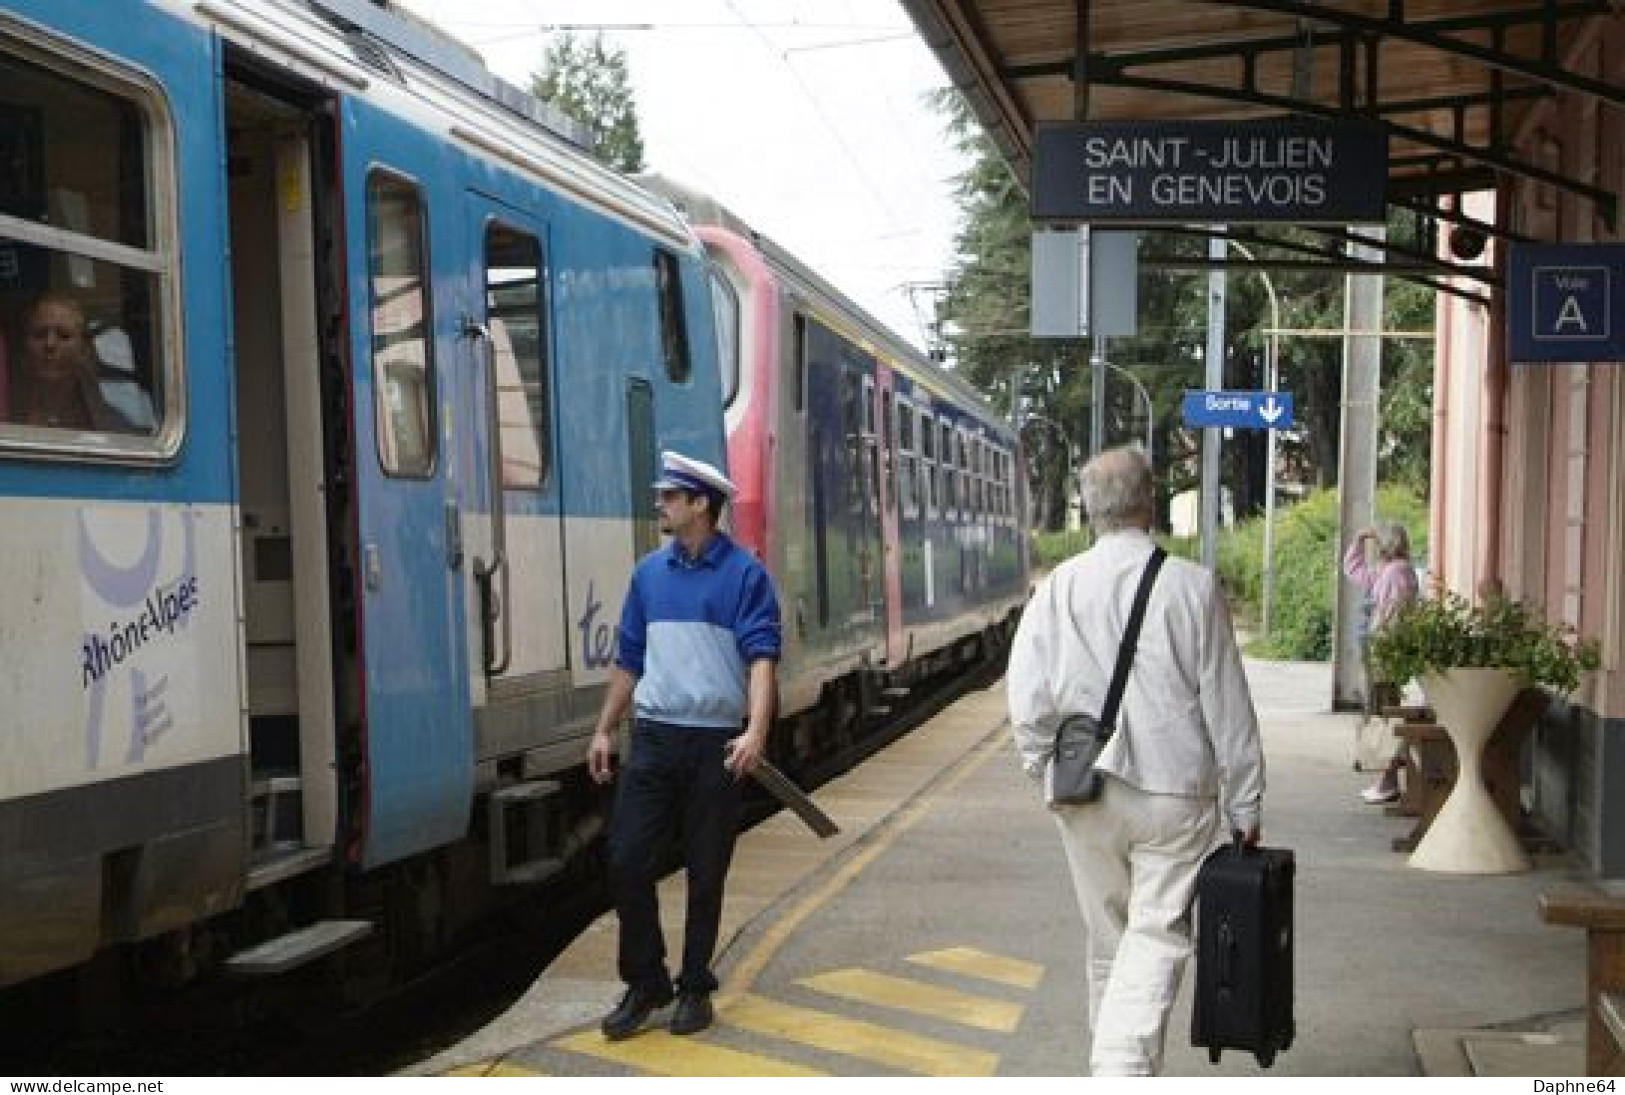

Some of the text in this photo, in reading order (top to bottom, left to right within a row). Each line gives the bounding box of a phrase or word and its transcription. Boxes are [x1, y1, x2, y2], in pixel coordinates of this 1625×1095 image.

[1088, 174, 1326, 205] EN GENEVOIS
[1555, 296, 1587, 332] A
